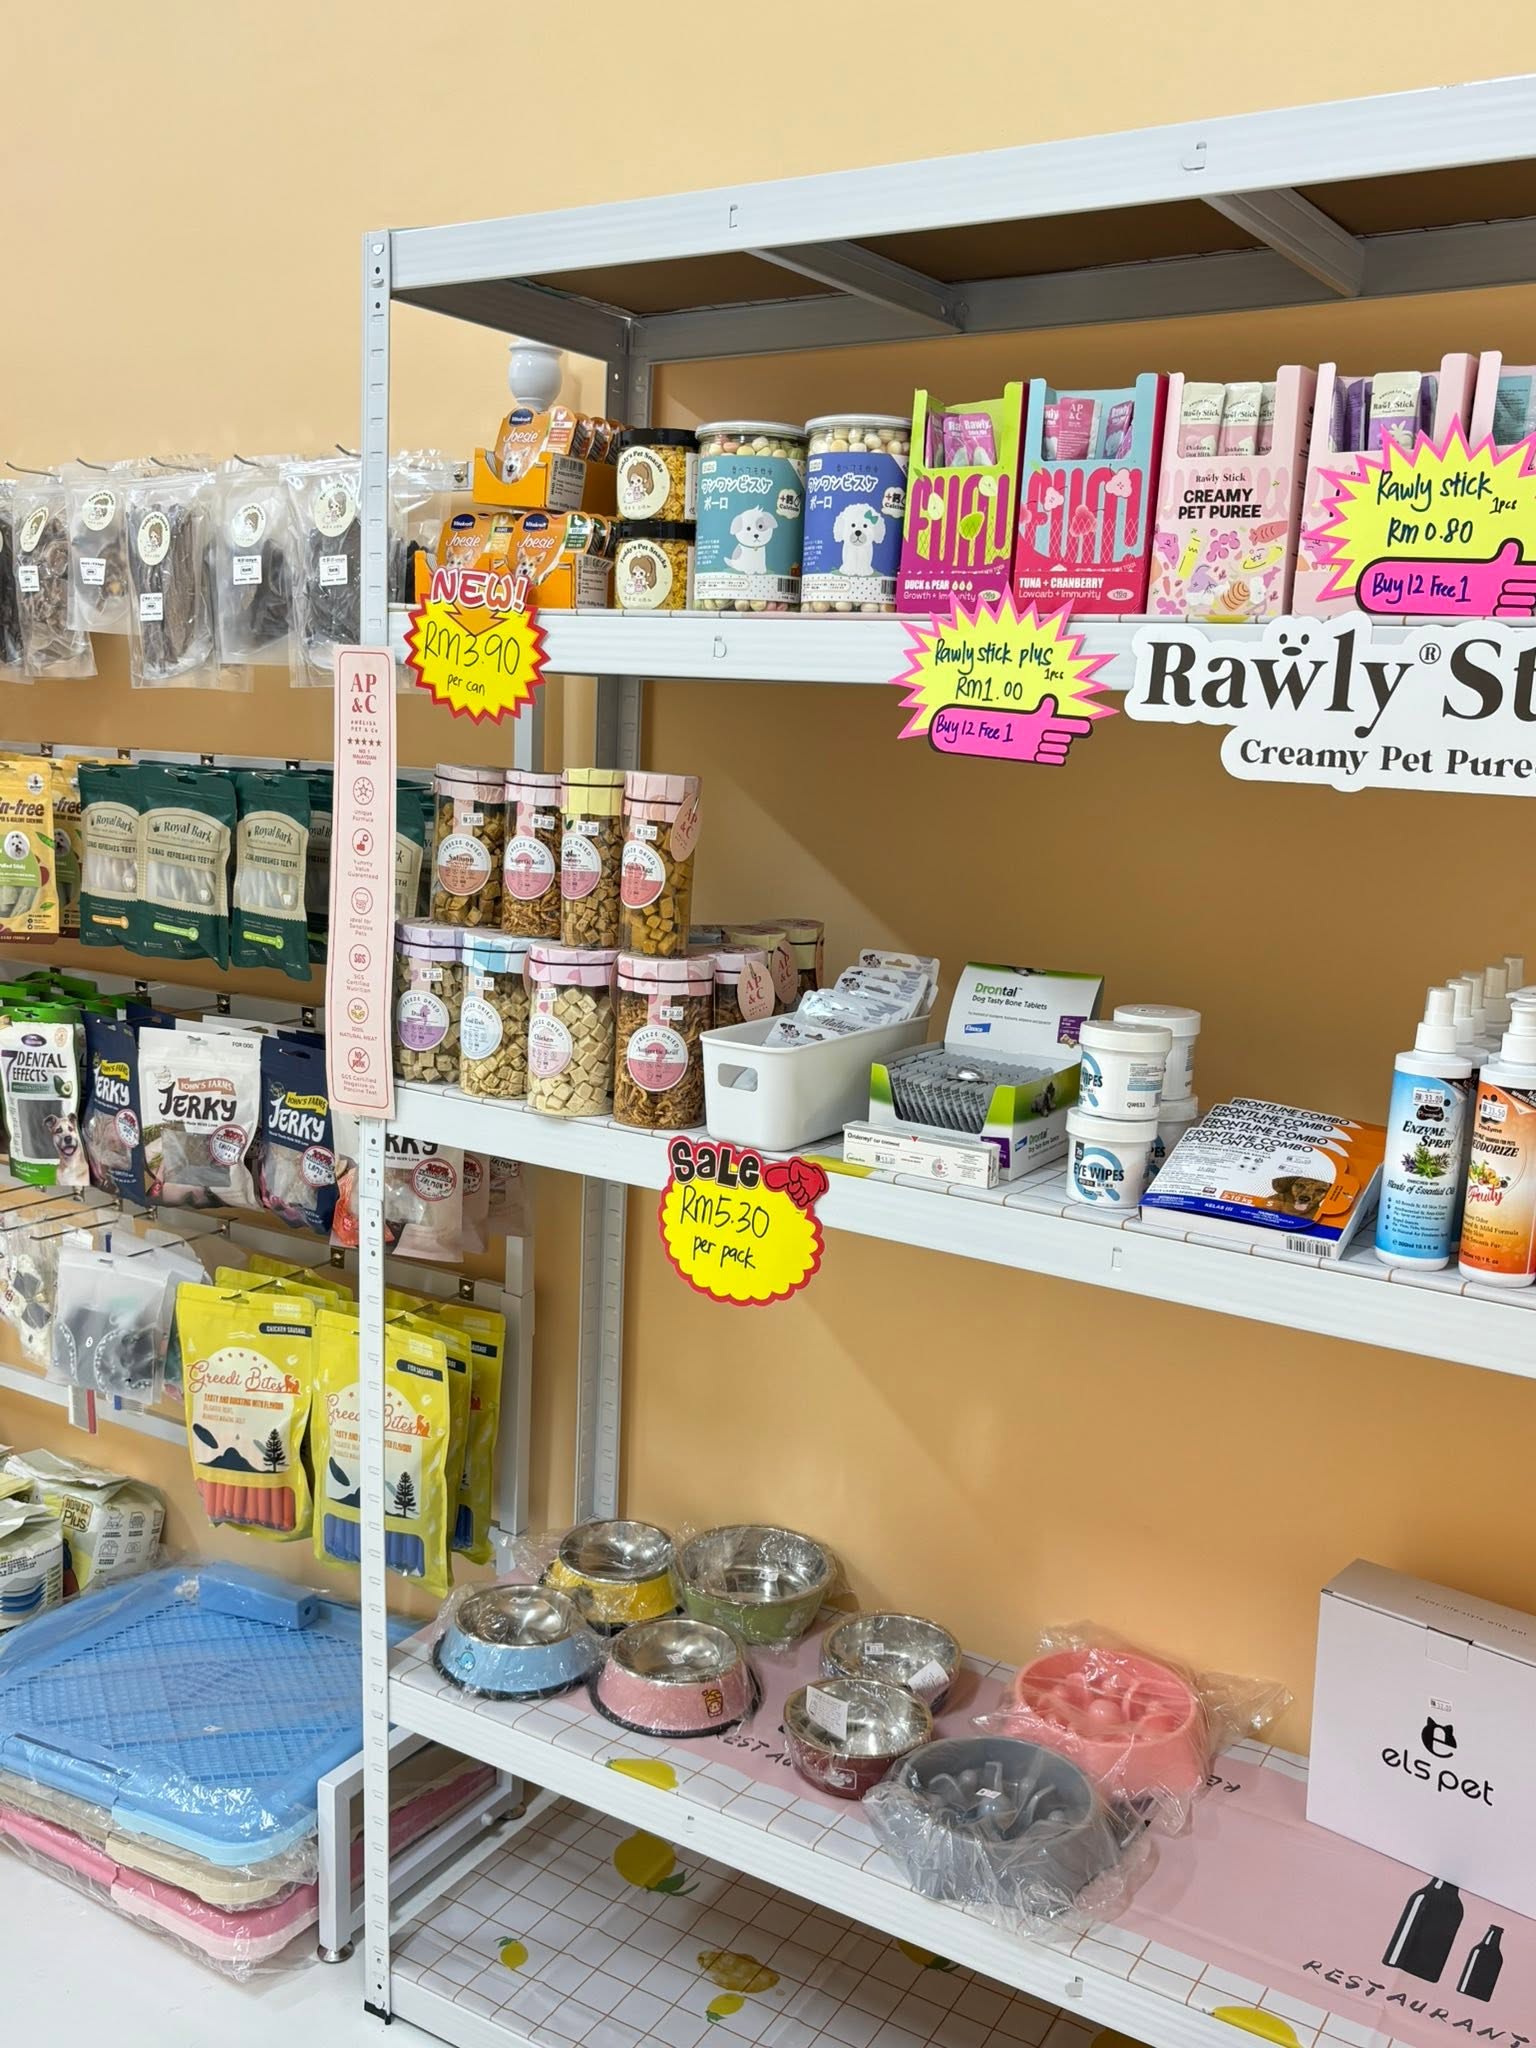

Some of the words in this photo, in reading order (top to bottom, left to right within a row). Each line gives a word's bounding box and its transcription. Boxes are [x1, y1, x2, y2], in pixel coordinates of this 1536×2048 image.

[1222, 472, 1246, 482] Stick
[1183, 488, 1253, 503] CREAMY
[1377, 469, 1433, 512] Rawly
[1178, 506, 1206, 520] PET
[1209, 505, 1262, 519] PUREE
[1425, 517, 1474, 544] 0.80
[430, 567, 529, 614] NEW!
[904, 580, 925, 590] DUCK
[931, 581, 950, 590] PEAR
[1019, 578, 1041, 589] TUNA
[1050, 577, 1104, 589] CRANBERRY
[1372, 572, 1404, 605] Buy
[1407, 573, 1425, 596] 12
[1430, 575, 1456, 597] Free
[1455, 575, 1472, 603] 1
[935, 638, 975, 676] Rawly
[350, 673, 377, 693] AP
[447, 673, 463, 691] per
[466, 682, 486, 697] can
[351, 694, 377, 714] &C
[935, 715, 960, 744] Buy
[961, 721, 976, 737] 12
[978, 722, 1001, 740] Free
[1002, 723, 1014, 743] 1
[1240, 738, 1369, 776] Creamy
[1380, 745, 1433, 773] Pet
[96, 814, 118, 827] Royal
[117, 817, 135, 834] Bark
[163, 821, 190, 834] Royal
[191, 826, 213, 843] Bark
[254, 825, 275, 838] Royal
[275, 827, 293, 846] Bark
[746, 976, 762, 990] AP
[749, 987, 765, 1005] &C
[972, 994, 986, 1004] Dog
[987, 996, 1004, 1006] Tasty
[1005, 999, 1022, 1007] Bone
[1024, 1001, 1047, 1011] Tablets
[17, 1051, 67, 1069] DENTAL
[12, 1067, 48, 1083] EFFECTS
[158, 1081, 237, 1122] JERKY
[1232, 1099, 1301, 1117] FRONTLINE
[1300, 1110, 1350, 1126] COMBO
[268, 1094, 326, 1143] JERKY
[1212, 1104, 1285, 1124] FRONTLINE
[1283, 1117, 1334, 1133] COMBO
[1185, 1129, 1261, 1143] FRONTLINE
[1260, 1135, 1314, 1153] COMBO
[1203, 1117, 1278, 1137] FRONTLINE
[1276, 1127, 1328, 1145] COMBO
[1181, 1135, 1243, 1149] SPOT-ON
[1242, 1141, 1276, 1154] DOG
[1073, 1162, 1087, 1176] EYE
[1090, 1166, 1125, 1182] WIPES
[693, 1235, 717, 1261] per
[720, 1246, 757, 1270] pack
[187, 1360, 242, 1393] Greedi
[245, 1367, 286, 1394] Bites
[63, 1510, 87, 1530] Plus
[1382, 1747, 1432, 1781] els
[1437, 1770, 1495, 1806] pet
